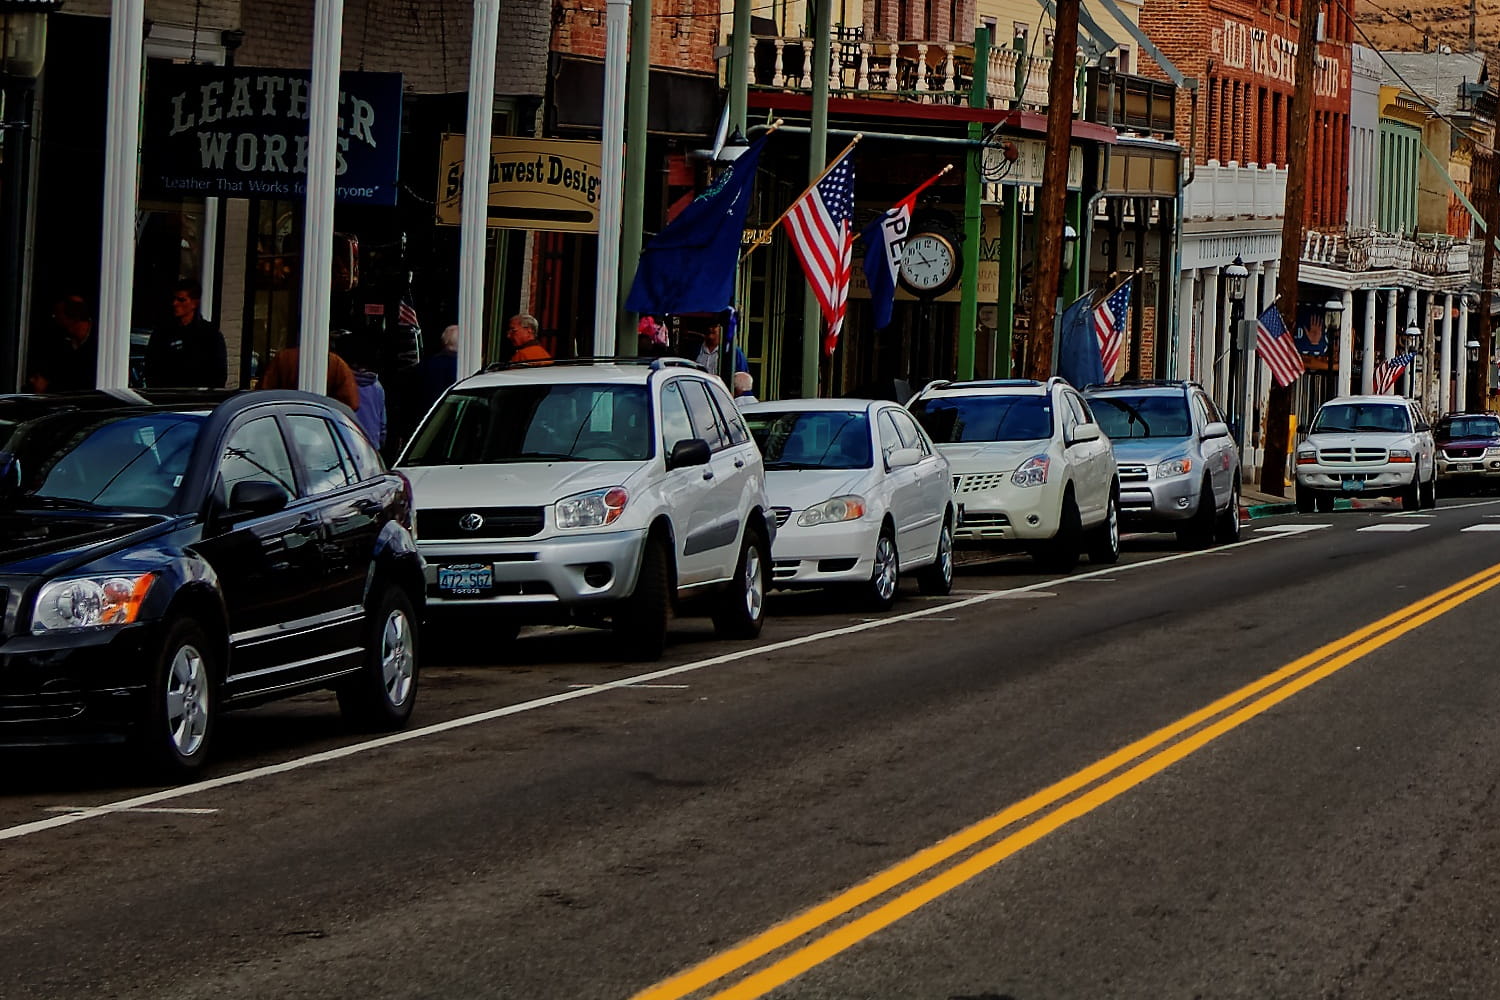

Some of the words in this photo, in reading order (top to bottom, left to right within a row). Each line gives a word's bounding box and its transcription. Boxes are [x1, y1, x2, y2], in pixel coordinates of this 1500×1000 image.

[216, 177, 243, 191] That
[249, 179, 289, 193] Works
[547, 156, 601, 203] Desig
